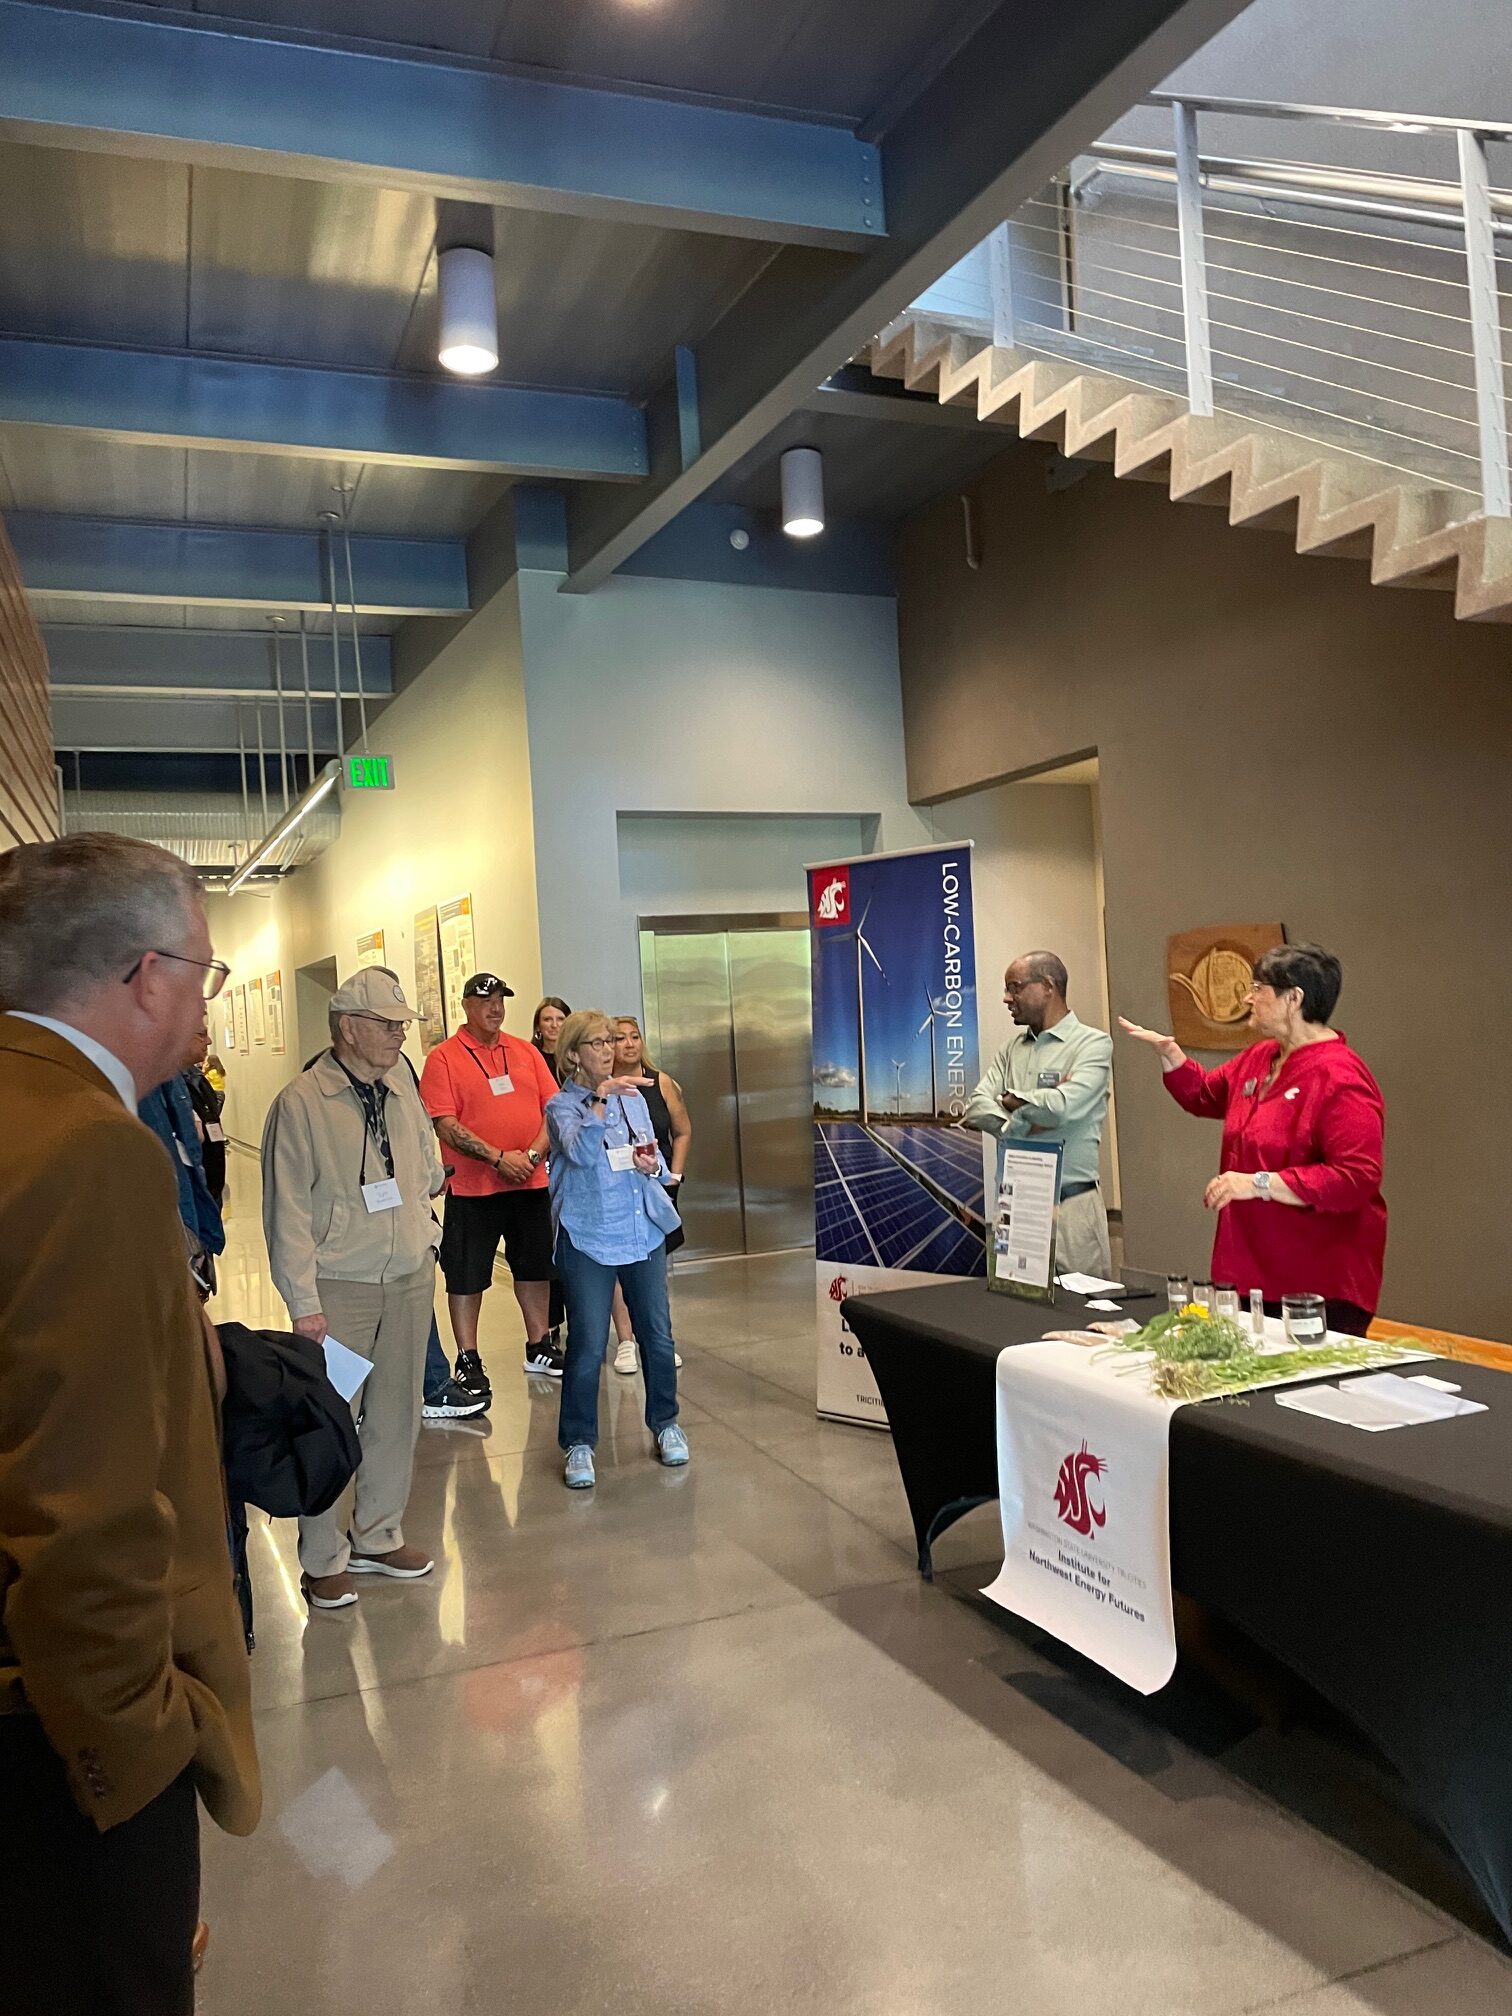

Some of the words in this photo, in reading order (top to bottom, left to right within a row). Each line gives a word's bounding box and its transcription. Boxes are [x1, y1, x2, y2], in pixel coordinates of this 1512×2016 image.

[350, 757, 388, 788] EXIT
[942, 862, 963, 1028] LOW-CARBON
[946, 1035, 967, 1134] ENERGY
[839, 1341, 854, 1356] to
[1029, 1548, 1073, 1582] Northwest
[1074, 1574, 1106, 1603] Energy
[1108, 1592, 1145, 1622] Futures
[1058, 1549, 1096, 1579] Institute
[1097, 1570, 1111, 1588] for
